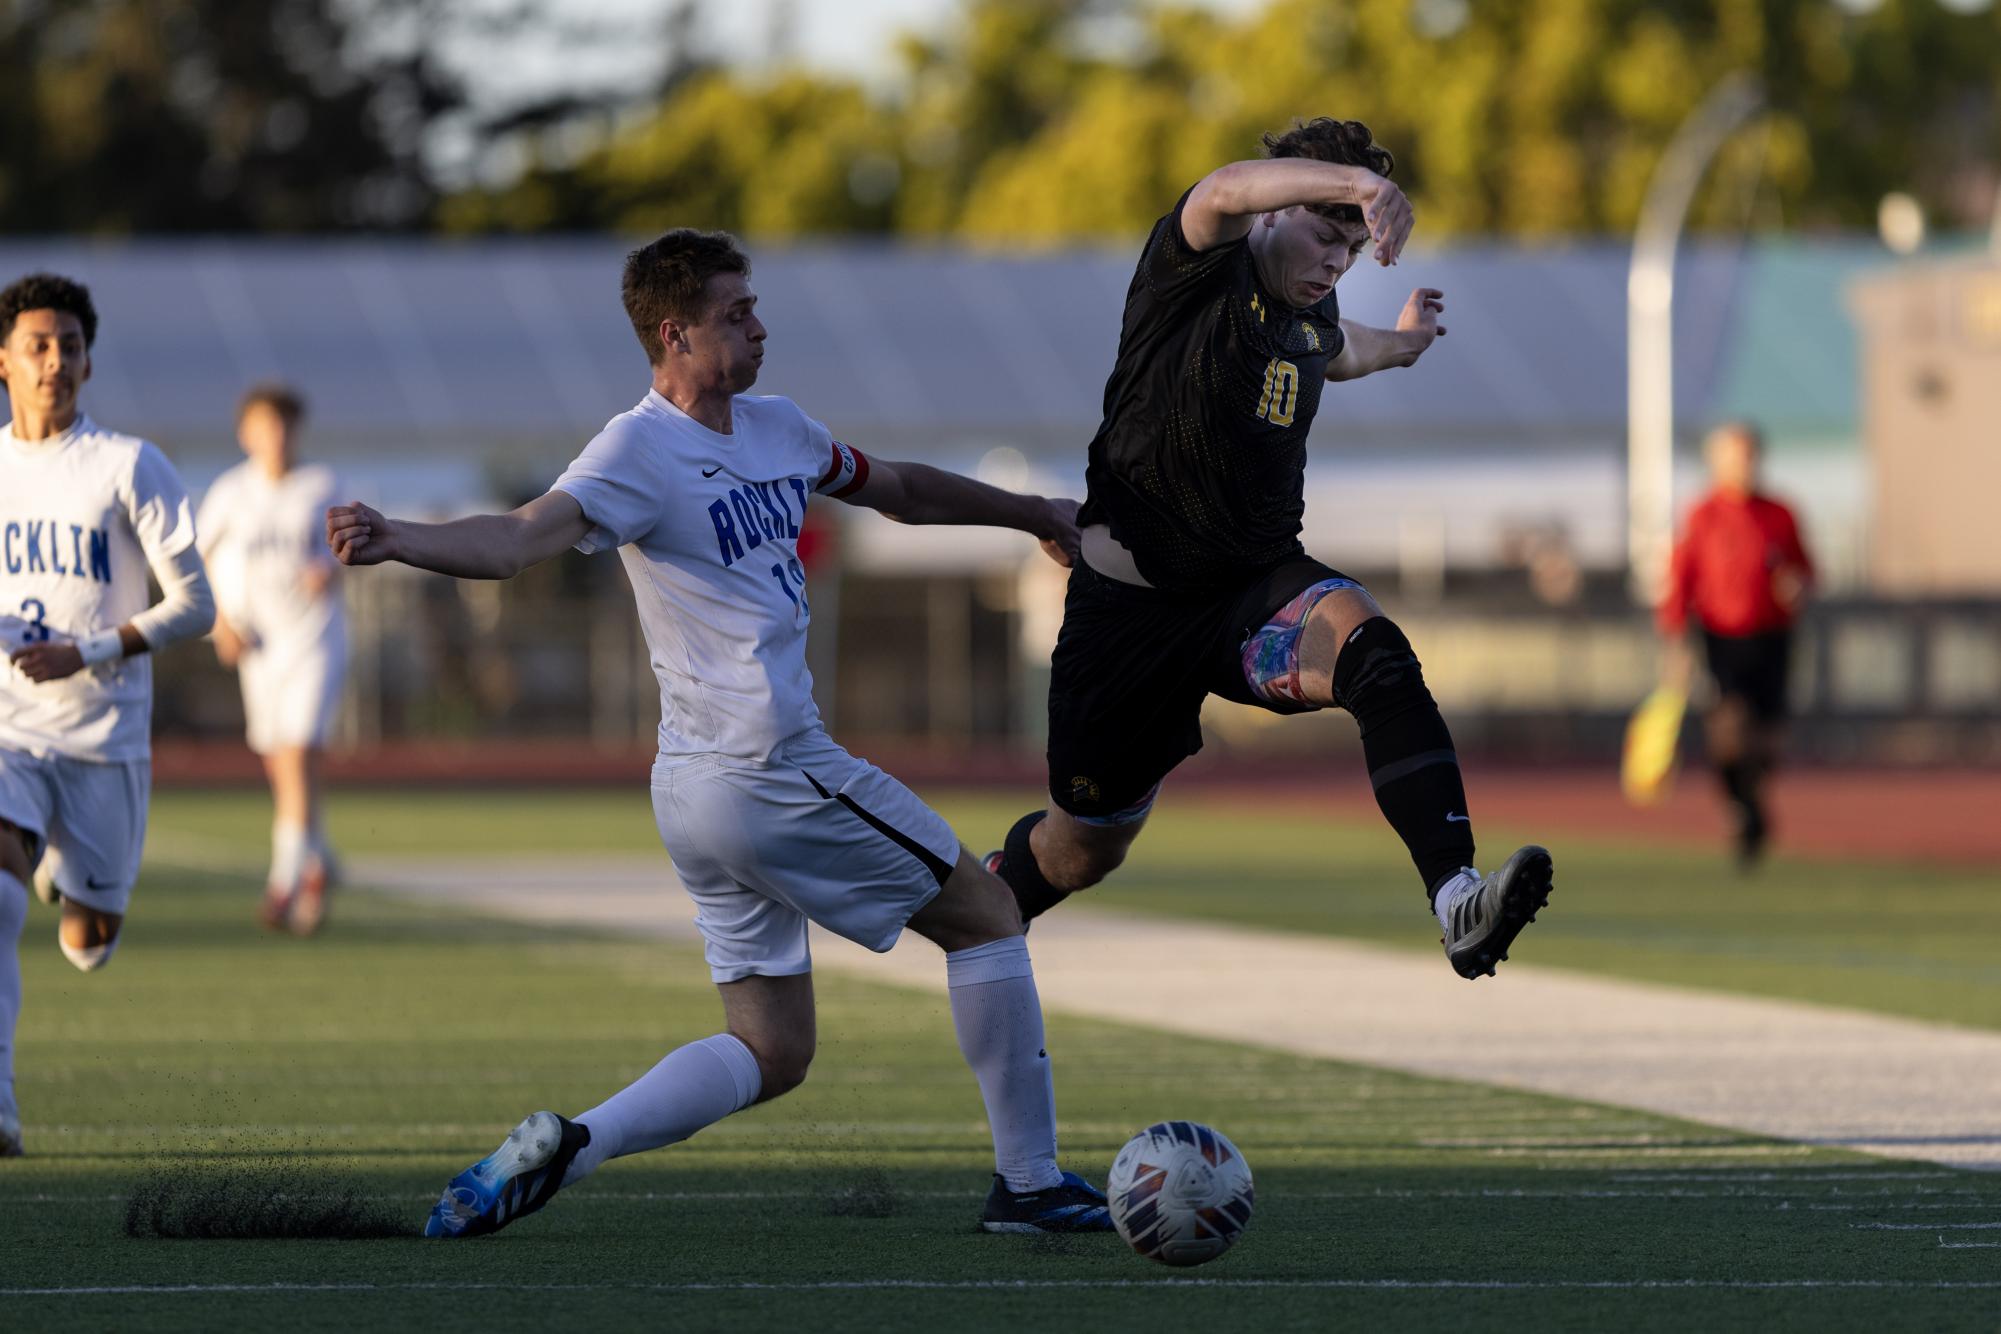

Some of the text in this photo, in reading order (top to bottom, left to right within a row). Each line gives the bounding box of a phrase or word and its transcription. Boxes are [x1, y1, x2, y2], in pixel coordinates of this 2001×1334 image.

[1256, 357, 1298, 427] 10
[0, 520, 111, 584] CKLIN
[708, 478, 809, 567] ROCKLI
[21, 598, 49, 641] 3
